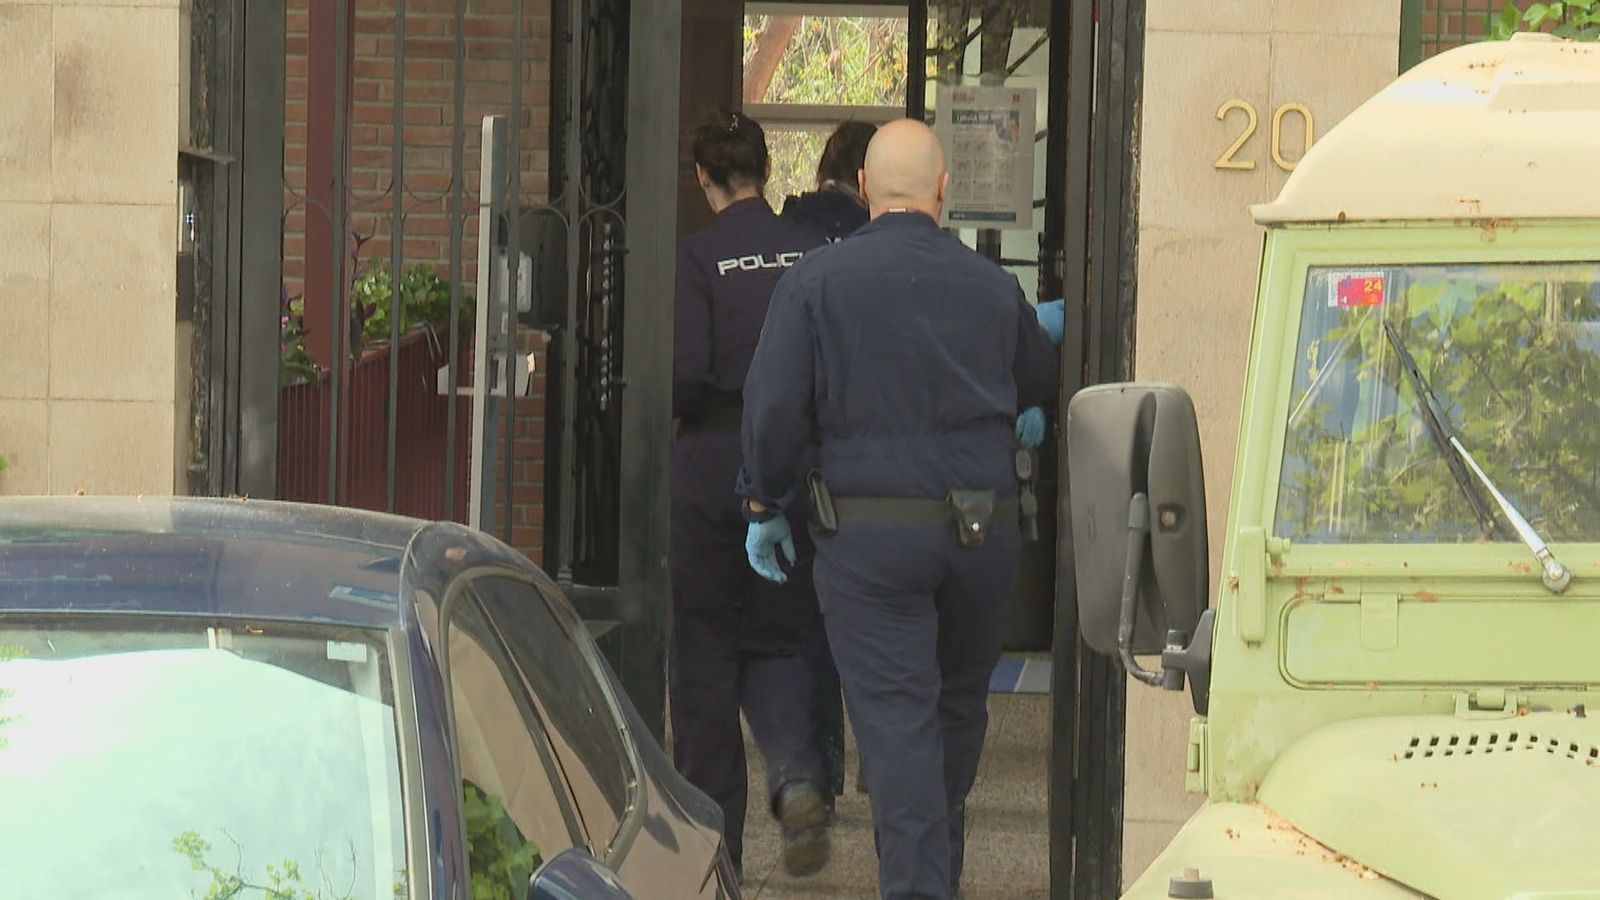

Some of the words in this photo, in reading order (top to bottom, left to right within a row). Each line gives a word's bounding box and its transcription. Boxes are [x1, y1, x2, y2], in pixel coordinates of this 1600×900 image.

[1215, 100, 1313, 171] 20
[717, 252, 803, 276] POLIC
[1363, 279, 1382, 292] 24
